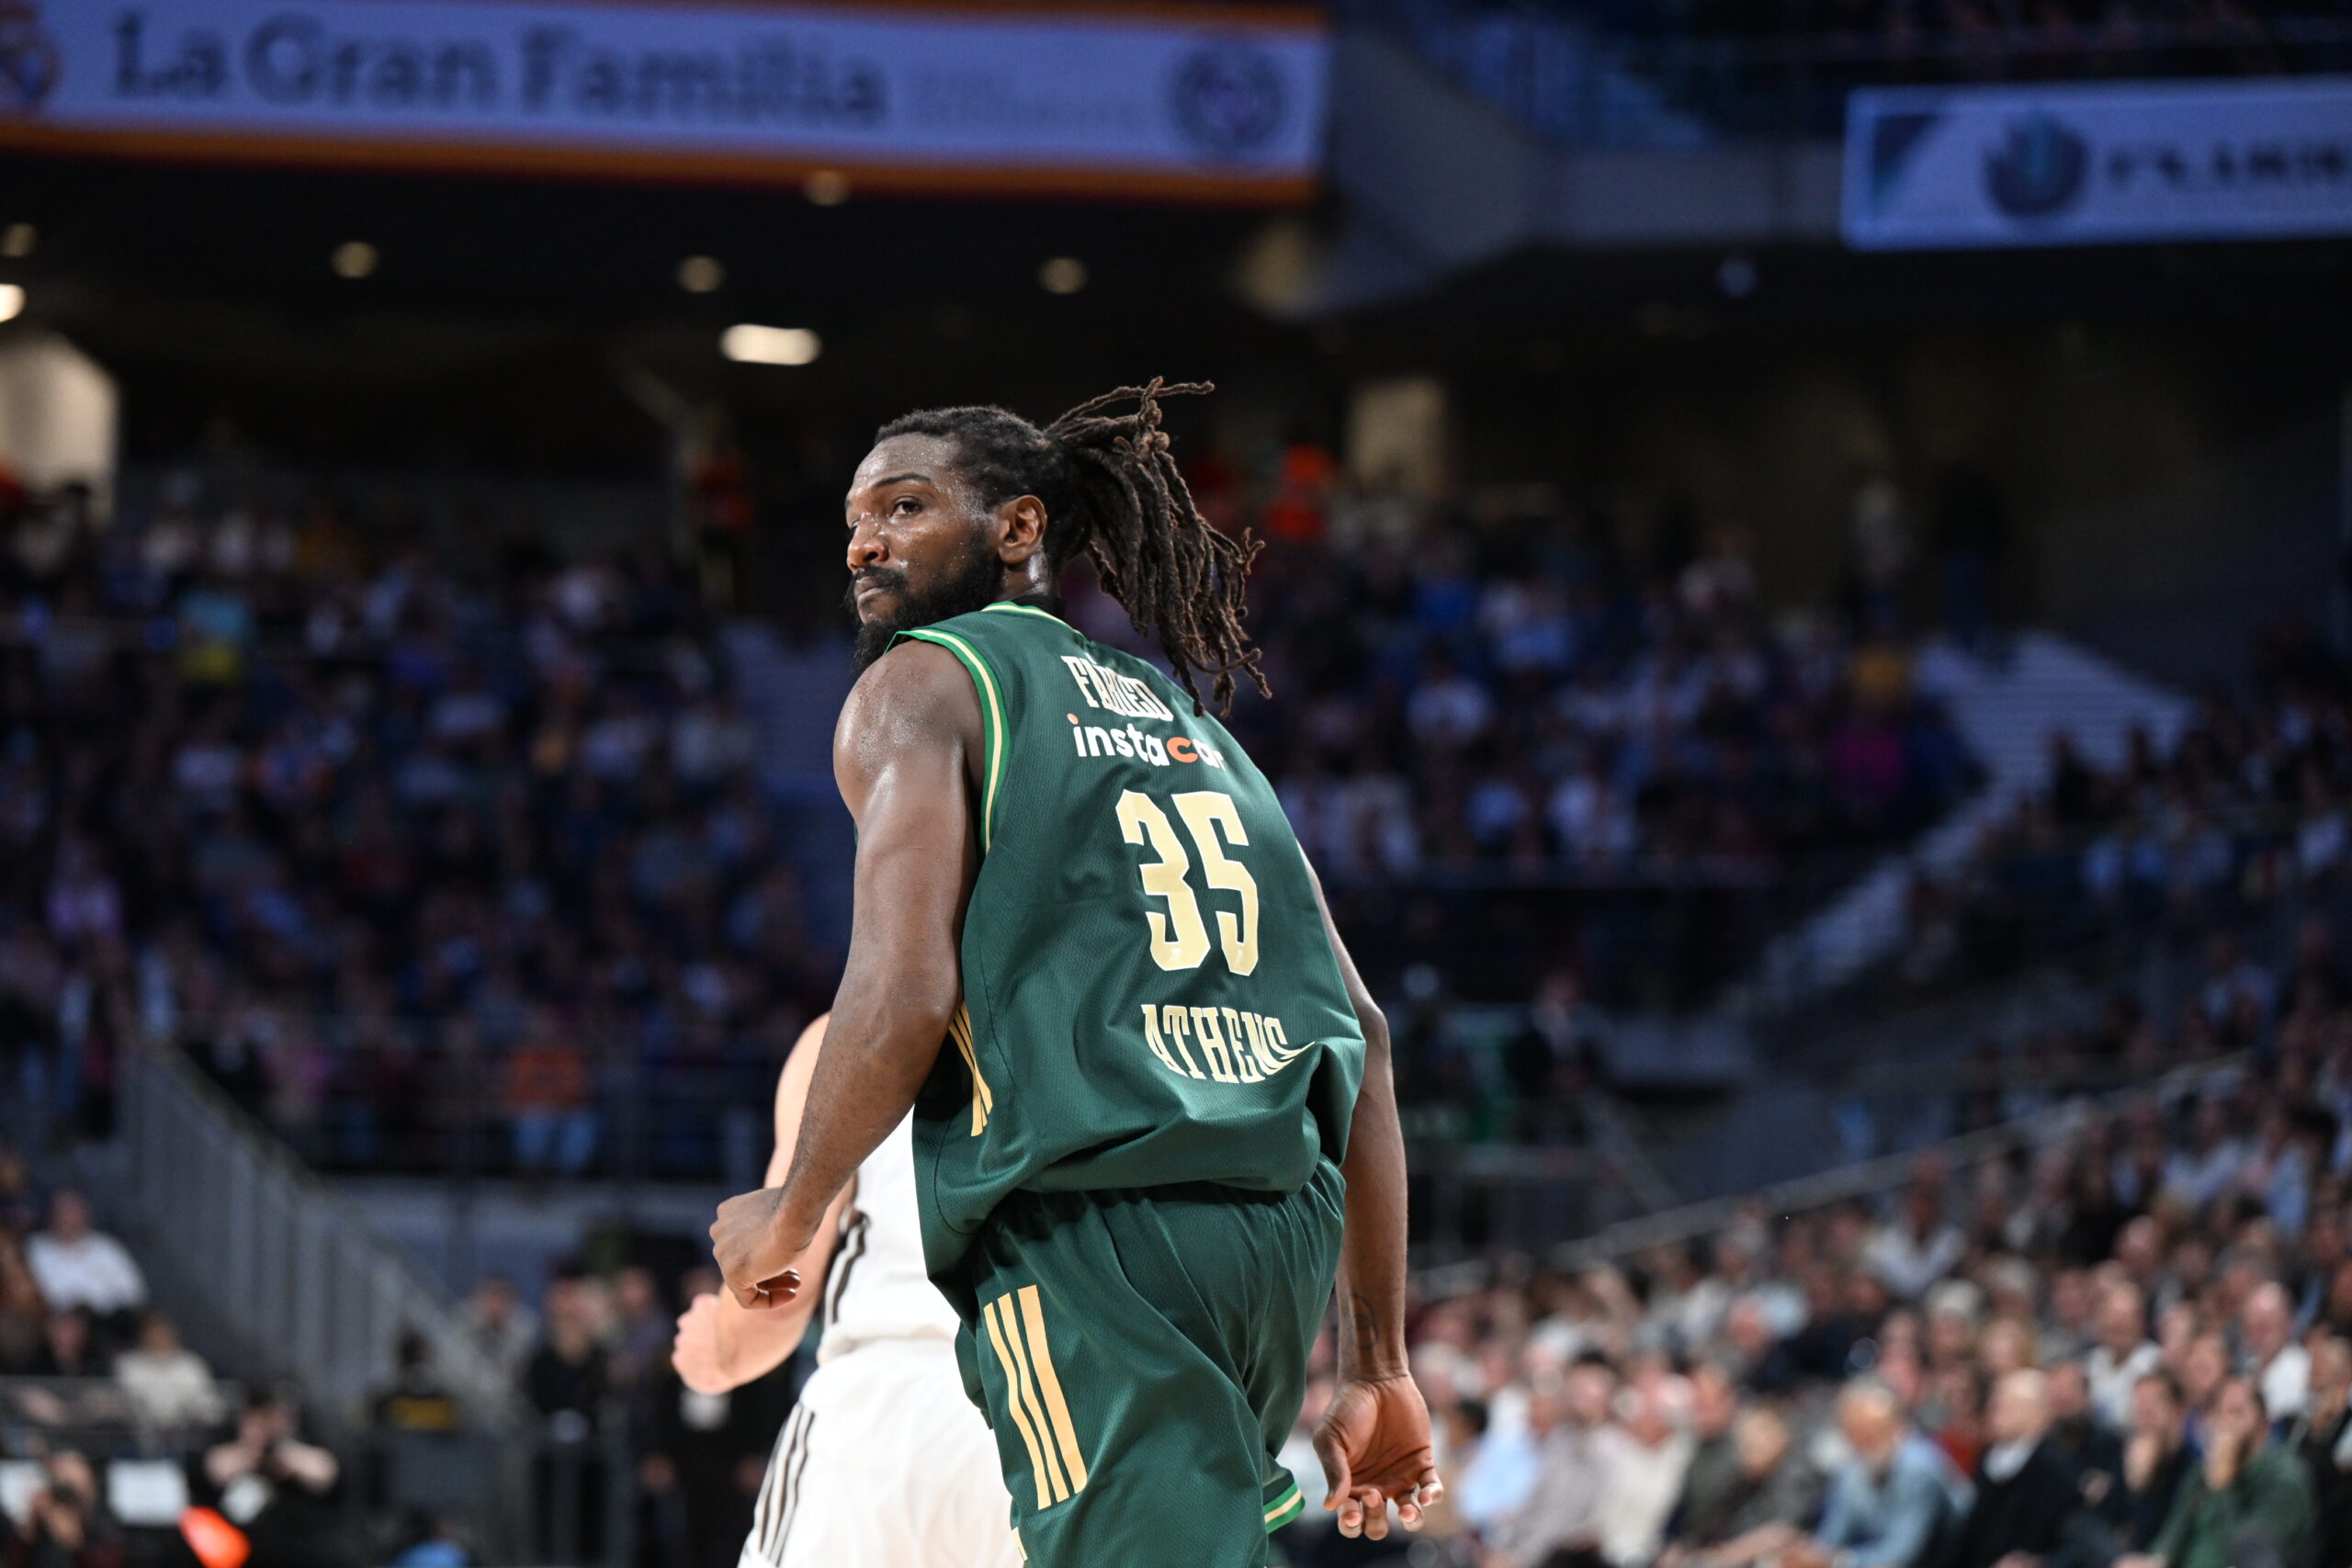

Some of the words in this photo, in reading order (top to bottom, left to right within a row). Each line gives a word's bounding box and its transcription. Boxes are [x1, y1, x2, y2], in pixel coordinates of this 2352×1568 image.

[116, 9, 228, 97] La
[244, 13, 498, 106] Gran
[1067, 713, 1227, 772] instacar
[1115, 789, 1260, 976] 35
[1141, 1004, 1316, 1084] ATHENS
